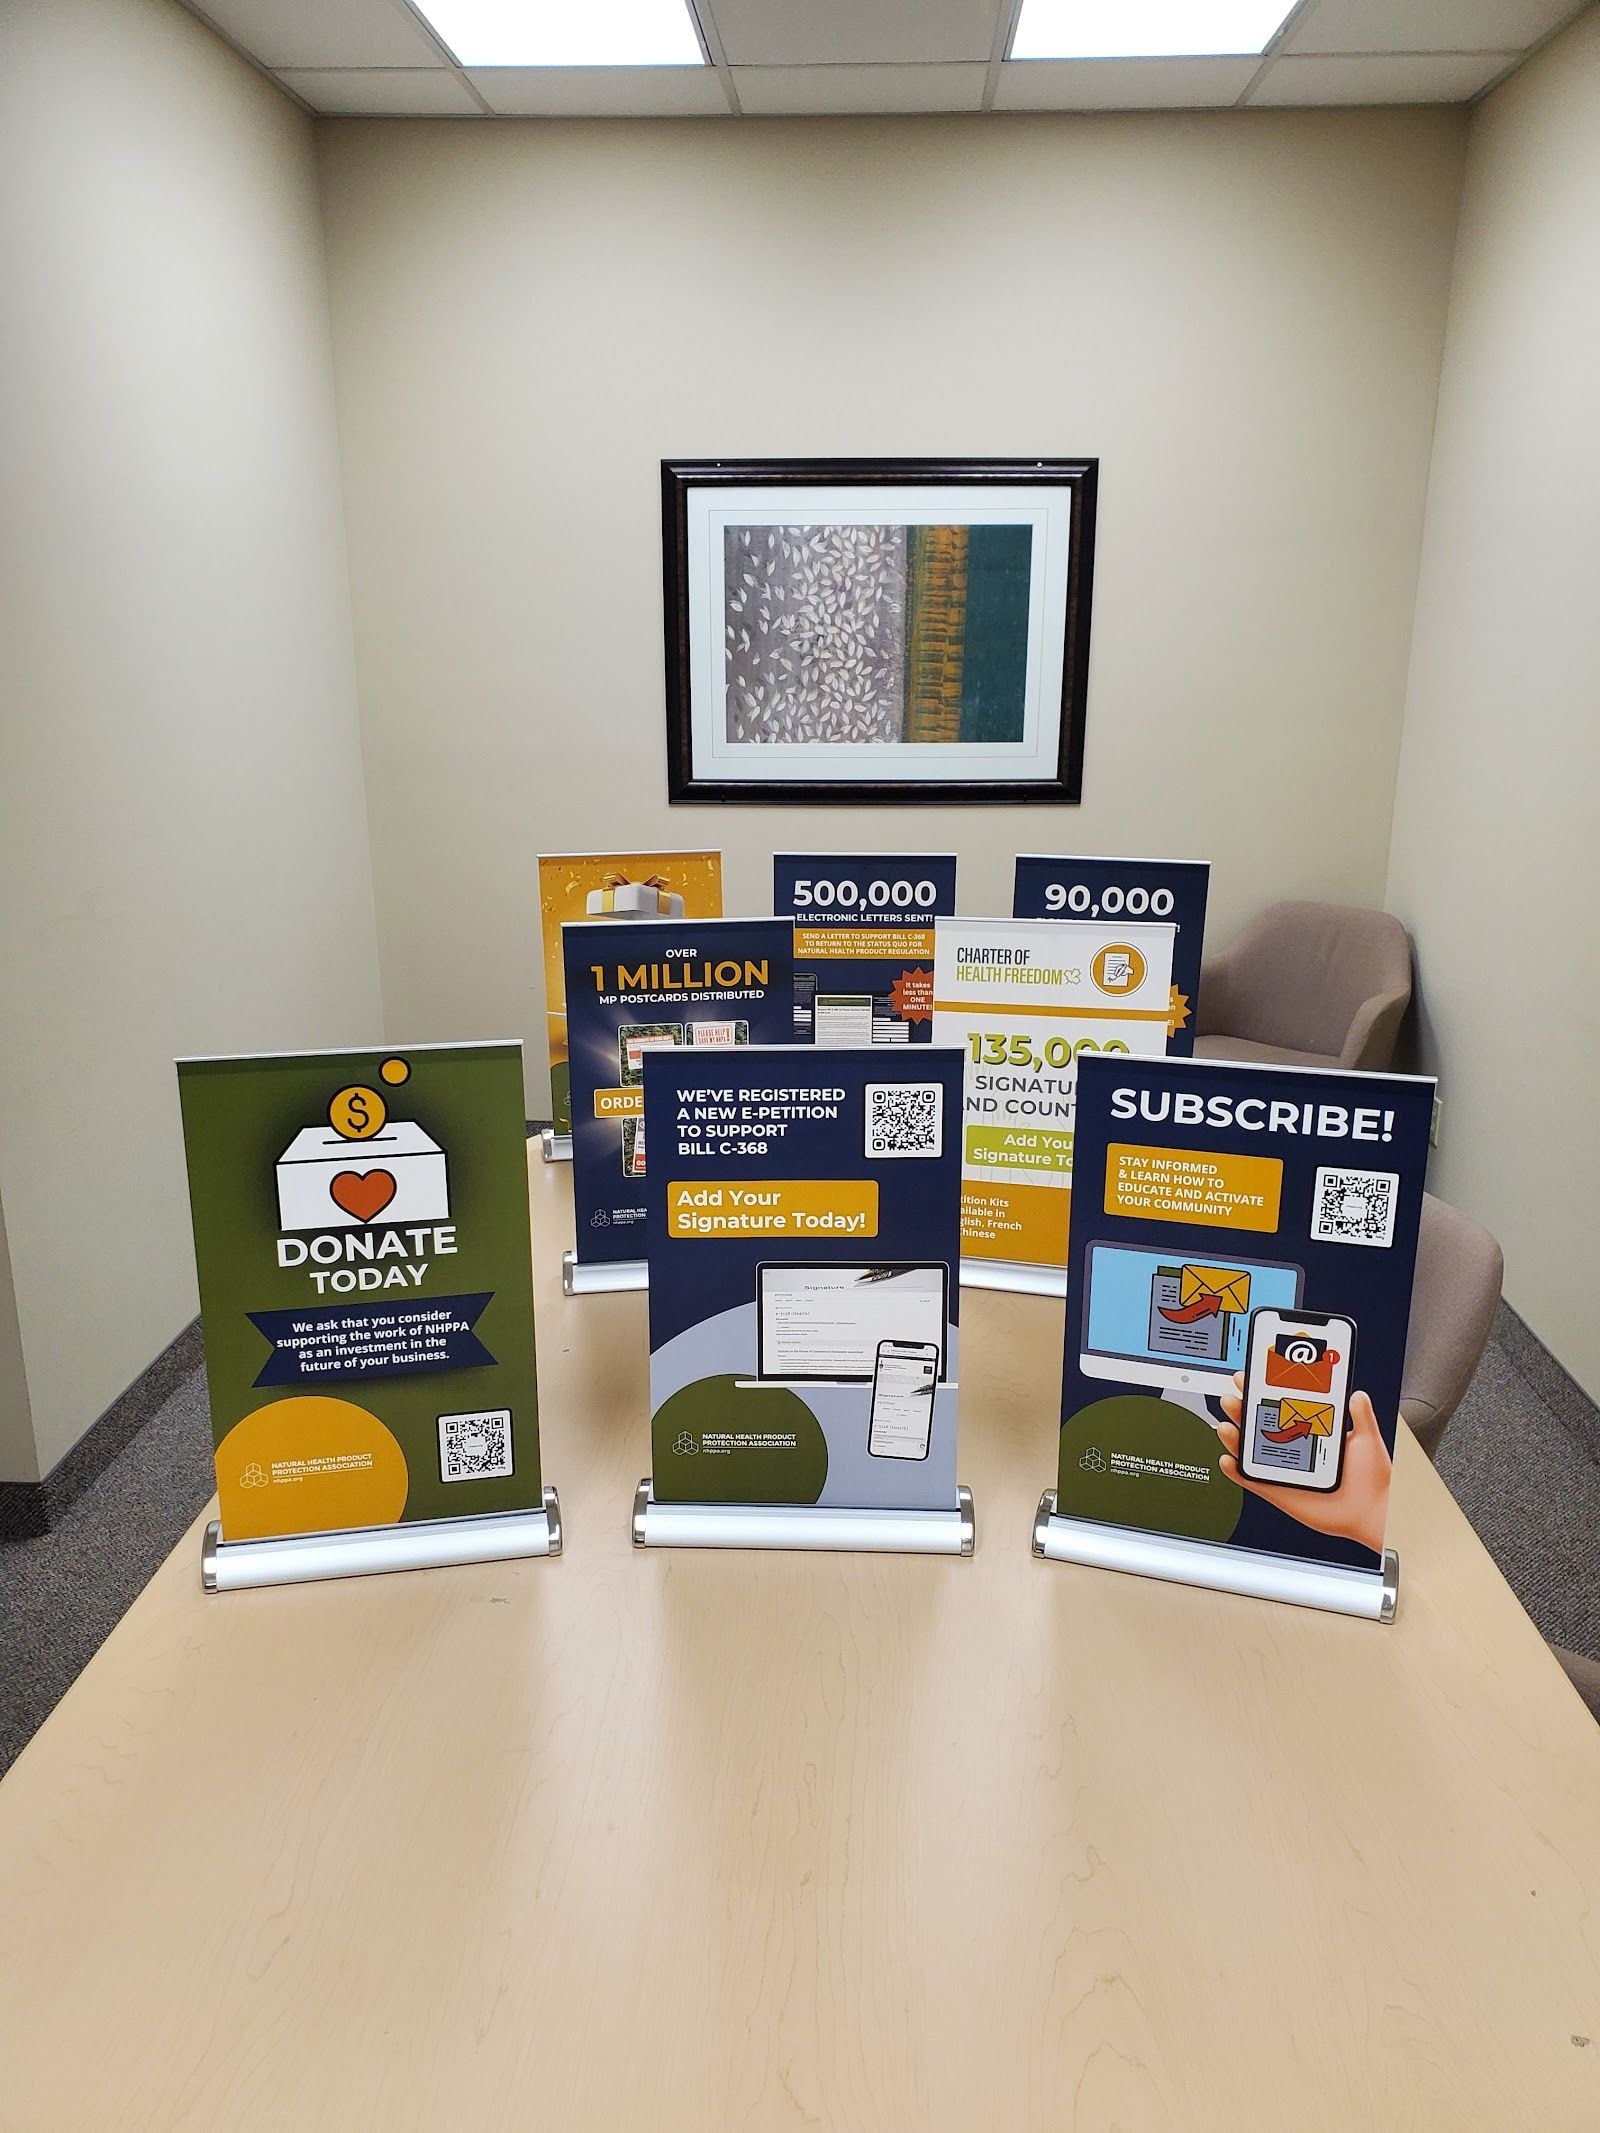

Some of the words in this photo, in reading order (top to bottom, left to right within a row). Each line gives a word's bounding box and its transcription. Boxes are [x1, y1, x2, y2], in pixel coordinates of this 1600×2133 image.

[793, 880, 937, 911] 500,000
[1045, 884, 1174, 917] 90,000
[797, 913, 858, 922] ELECTRONIC
[861, 913, 902, 922] LETTERS
[905, 914, 933, 922] SENT!
[802, 932, 820, 940] SEND
[867, 940, 891, 948] STATUS
[893, 940, 908, 949] QUO
[666, 948, 697, 958] OVER
[957, 947, 1012, 965] CHARTER
[1015, 949, 1030, 966] OF
[591, 966, 604, 991] 1
[618, 960, 768, 991] MILLION
[956, 966, 1001, 983] HEALTH
[1004, 967, 1063, 986] FREEDOM
[600, 995, 618, 1005] MP
[620, 993, 688, 1004] POSTCARDS
[691, 990, 765, 1001] DISTRIBUTED
[976, 1075, 1078, 1096] SIGNATU
[676, 1088, 734, 1103] WE'VE
[738, 1088, 846, 1102] REGISTERED
[963, 1097, 998, 1112] ND
[676, 1108, 691, 1120] A
[694, 1107, 737, 1120] NEW
[741, 1106, 838, 1120] E-PETITION
[1110, 1088, 1396, 1142] SUBSCRIBE!
[677, 1124, 702, 1138] TO
[706, 1124, 788, 1138] SUPPORT
[678, 1142, 716, 1156] BILL
[719, 1142, 768, 1156] C-368
[1004, 1134, 1037, 1148] Add
[973, 1148, 1052, 1164] Signature
[1119, 1156, 1150, 1168] STAY
[1152, 1159, 1218, 1175] INFORMED
[1118, 1169, 1128, 1179] &
[1130, 1170, 1170, 1184] LEARN
[1173, 1174, 1204, 1187] HOW
[1208, 1178, 1224, 1188] TO
[676, 1190, 723, 1207] Add
[728, 1190, 781, 1206] Your
[990, 1198, 1010, 1208] Kits
[1118, 1182, 1172, 1197] EDUCATE
[1174, 1188, 1202, 1200] AND
[1204, 1192, 1264, 1206] ACTIVATE
[995, 1209, 1006, 1218] in
[1116, 1194, 1152, 1207] YOUR
[1154, 1198, 1233, 1216] COMMUNITY
[677, 1212, 787, 1233] Signature
[792, 1212, 866, 1232] Today!
[988, 1220, 1022, 1230] French
[276, 1226, 458, 1268] DONATE
[309, 1264, 429, 1294] TODAY
[292, 1322, 314, 1334] We
[316, 1319, 340, 1332] ask
[342, 1317, 369, 1330] that
[371, 1316, 396, 1329] you
[398, 1310, 452, 1324] consider
[276, 1332, 348, 1349] supporting
[350, 1330, 372, 1342] the
[374, 1328, 407, 1340] work
[410, 1325, 424, 1336] of
[425, 1321, 470, 1335] NHPPA
[298, 1350, 315, 1360] as
[316, 1348, 333, 1358] an
[336, 1341, 408, 1356] investment
[410, 1338, 423, 1349] in
[425, 1336, 447, 1348] the
[300, 1359, 342, 1372] future
[344, 1357, 358, 1369] of
[360, 1356, 390, 1370] your
[392, 1350, 450, 1364] business.
[272, 1460, 306, 1469] NATURAL
[308, 1457, 336, 1466] HEALTH
[337, 1454, 372, 1463] PRODUCT
[272, 1466, 320, 1476] PROTECTION
[322, 1460, 373, 1471] ASSOCIATION
[1110, 1452, 1144, 1464] NATURAL
[1146, 1458, 1174, 1469] HEALTH
[1174, 1464, 1210, 1475] PRODUCT
[1110, 1459, 1158, 1472] PROTECTION
[1159, 1468, 1210, 1481] ASSOCIATION
